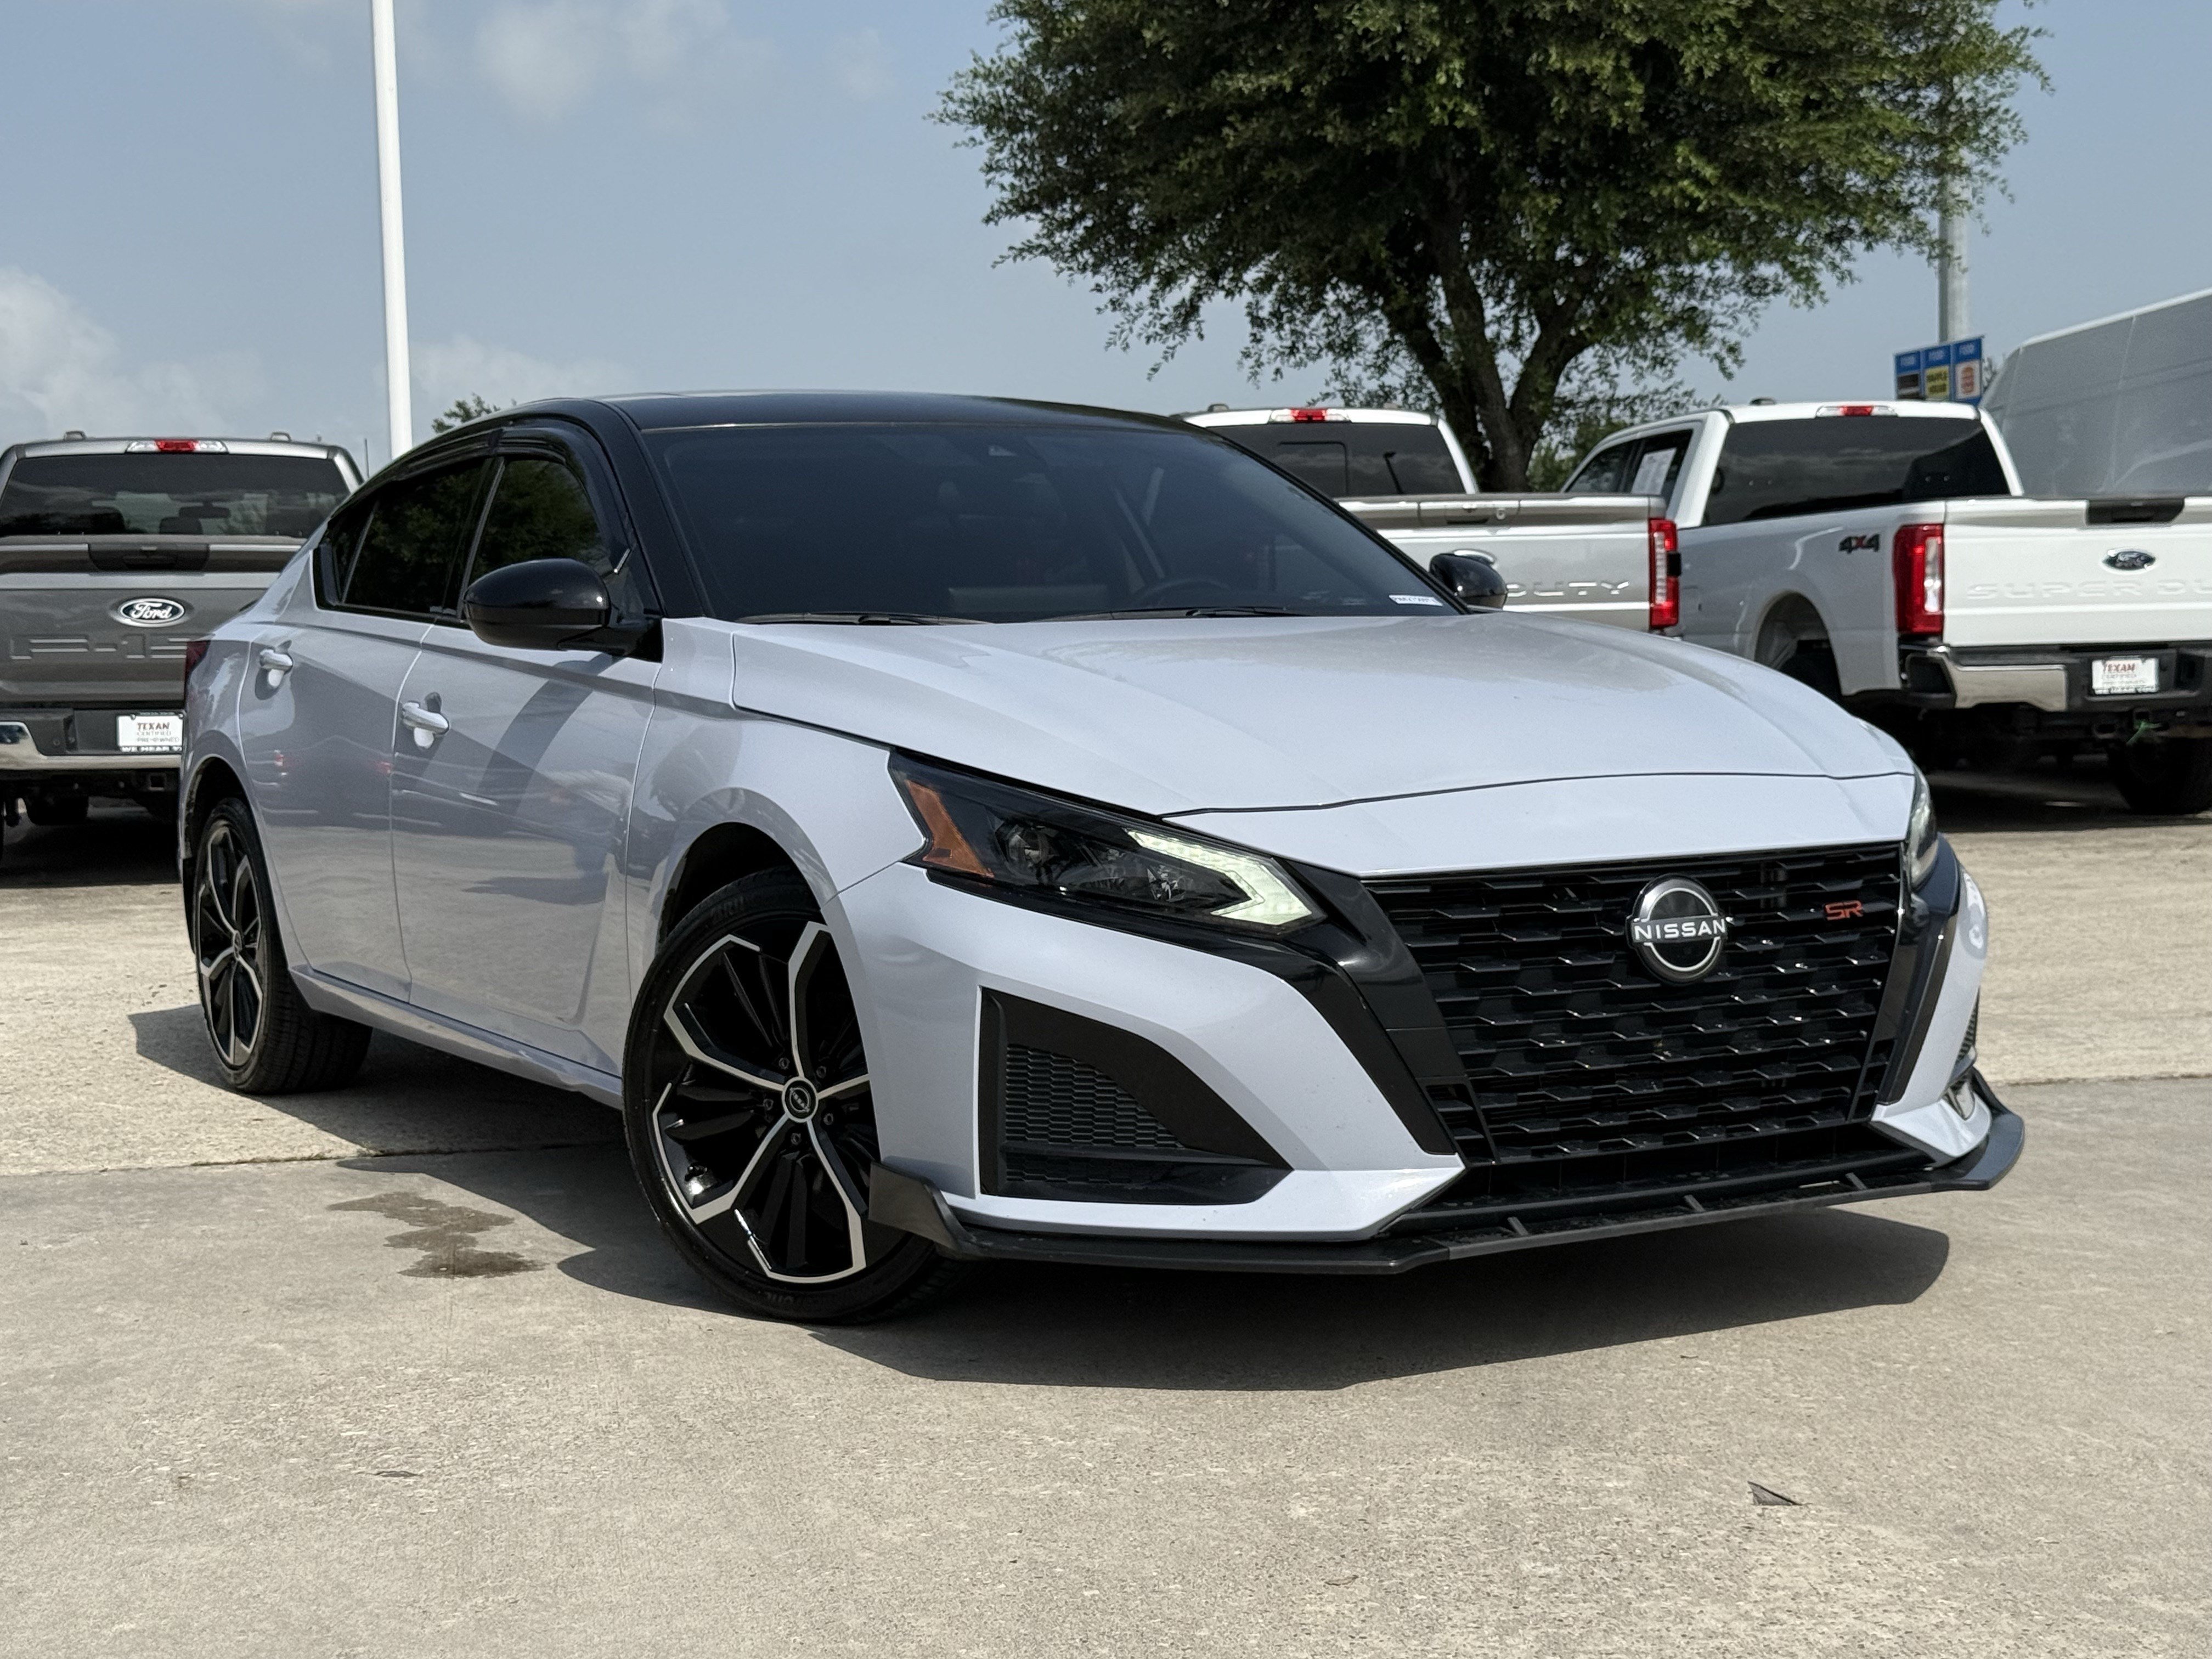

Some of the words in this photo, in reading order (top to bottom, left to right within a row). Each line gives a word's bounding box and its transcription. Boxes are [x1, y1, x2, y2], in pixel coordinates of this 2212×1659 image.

[1966, 579, 2144, 600] SUPER
[129, 602, 172, 620] Ford
[136, 721, 171, 730] TEXAN
[1825, 900, 1864, 921] SR
[1634, 918, 1726, 941] NISSAN
